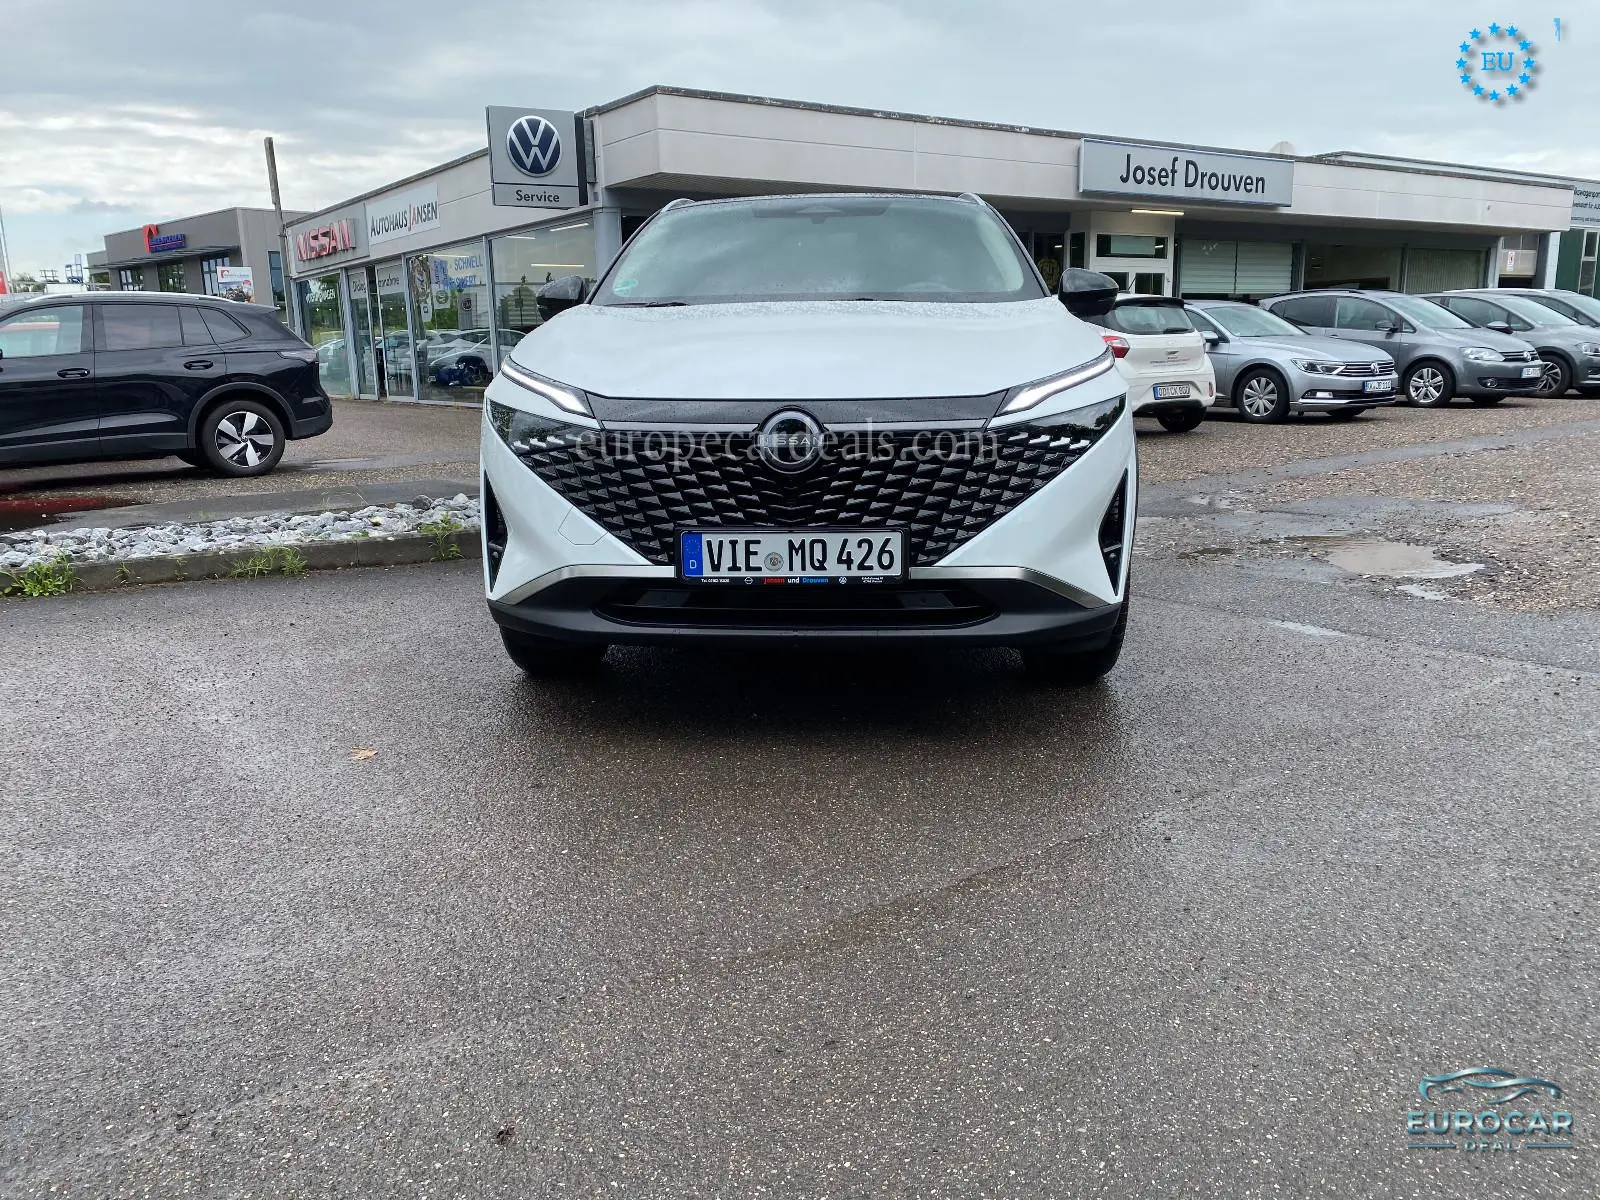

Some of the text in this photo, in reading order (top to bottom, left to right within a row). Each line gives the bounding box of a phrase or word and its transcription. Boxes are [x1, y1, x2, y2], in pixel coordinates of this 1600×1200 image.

[1119, 153, 1266, 194] Josef Drouven
[515, 189, 560, 203] Service
[370, 200, 438, 237] AUTOHAUS JANSEN
[296, 217, 355, 262] NISSAN
[454, 254, 484, 272] SCHNELL
[689, 559, 697, 569] D
[706, 537, 895, 572] VIE MQ 426
[787, 576, 800, 584] und
